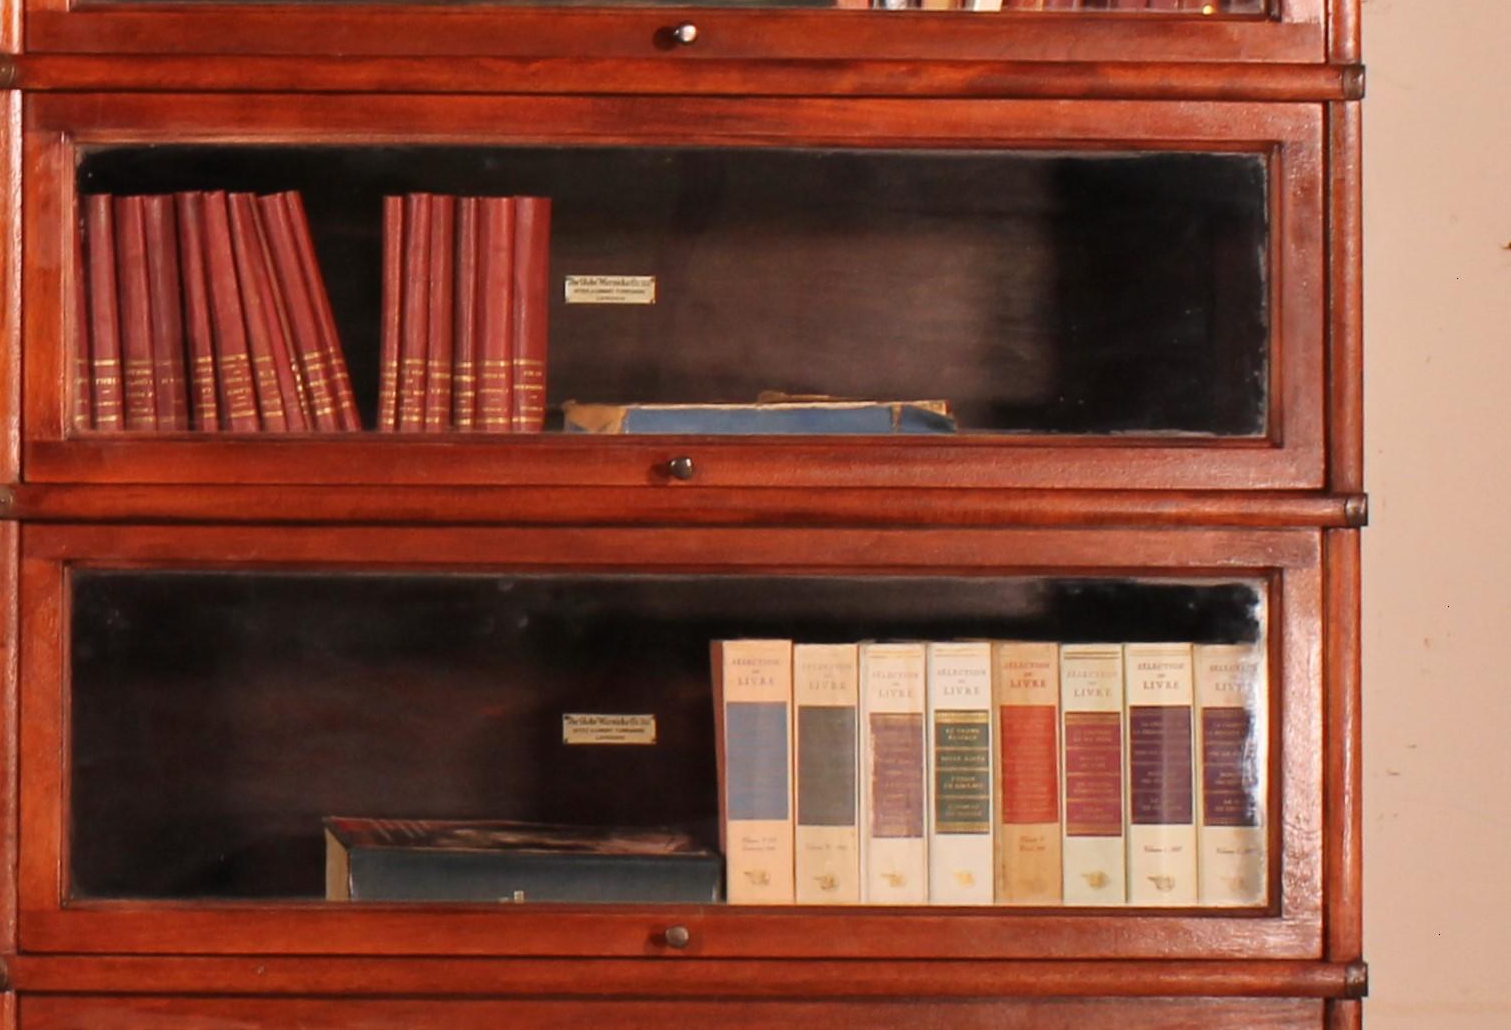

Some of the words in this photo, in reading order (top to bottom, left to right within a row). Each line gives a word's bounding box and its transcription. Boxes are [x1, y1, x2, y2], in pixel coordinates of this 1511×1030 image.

[1010, 678, 1047, 689] LIVRE
[1142, 680, 1181, 691] LIVRE
[943, 685, 981, 696] LIVRE
